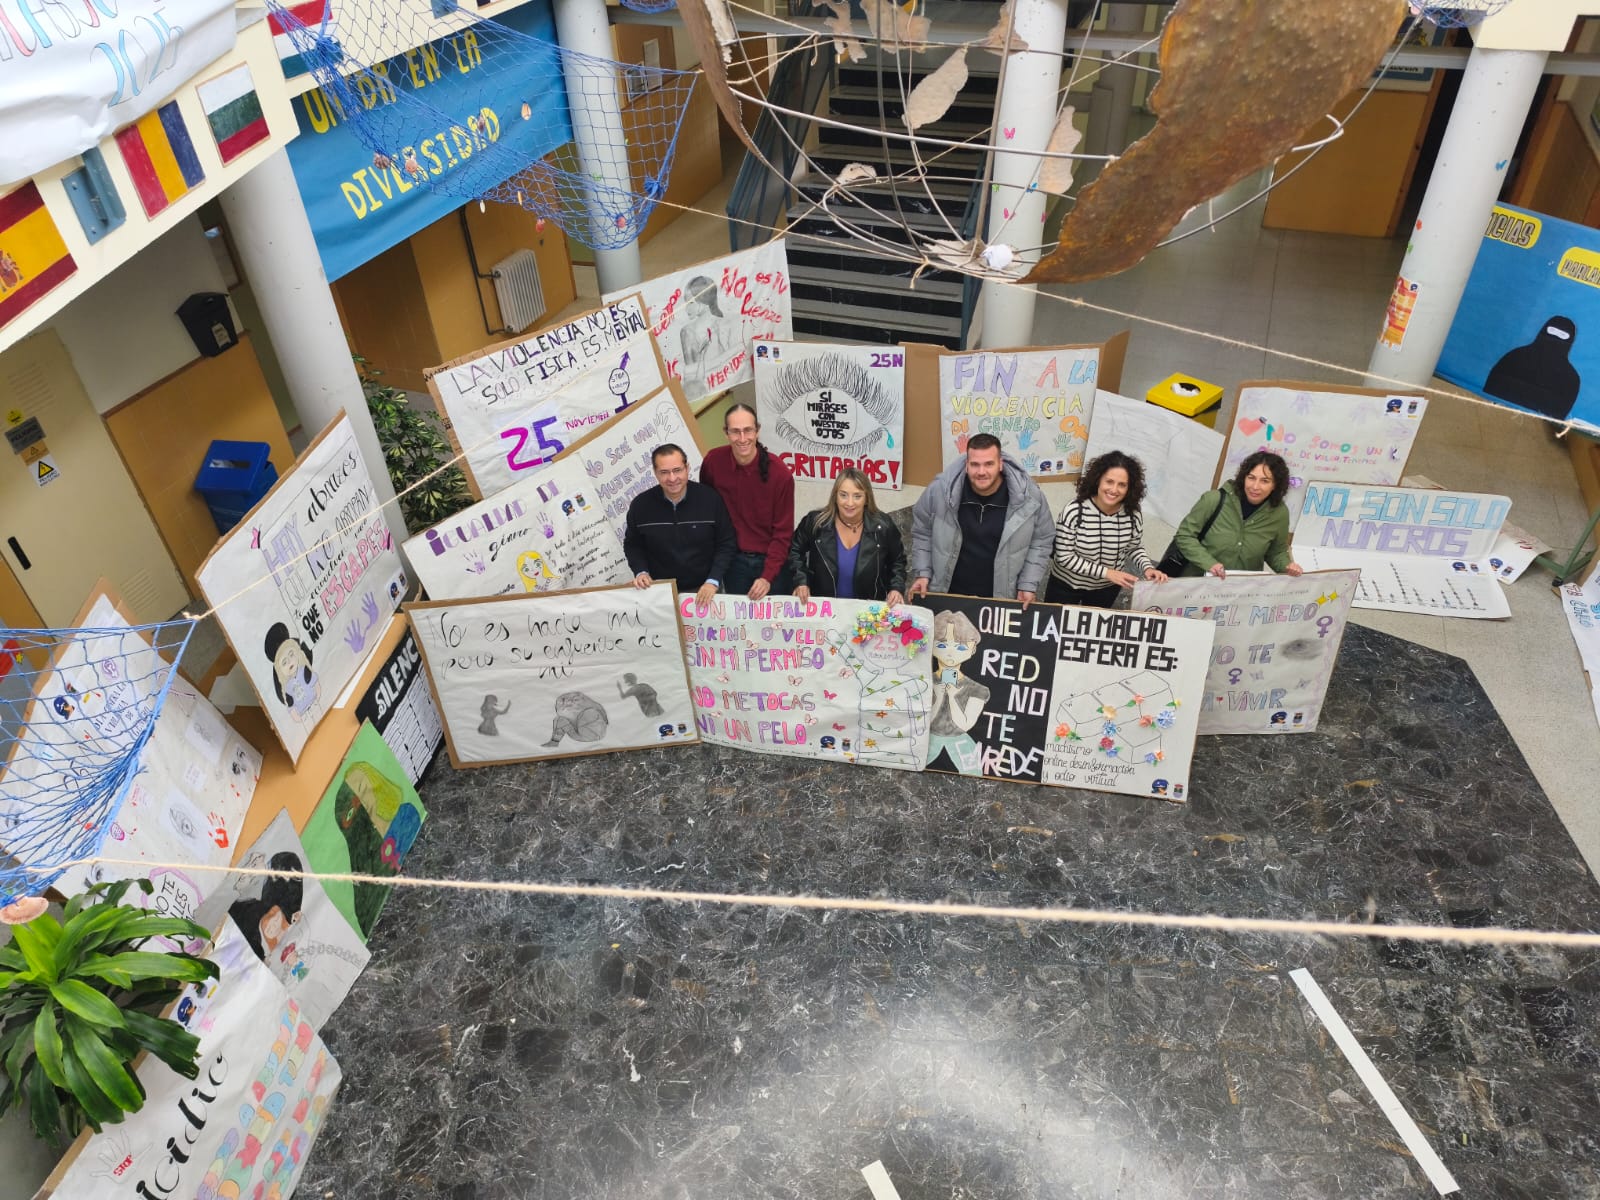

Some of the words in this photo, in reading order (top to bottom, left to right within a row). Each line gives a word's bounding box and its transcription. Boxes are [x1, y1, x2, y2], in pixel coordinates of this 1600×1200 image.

[406, 42, 441, 89] EN
[452, 29, 482, 74] LA
[1485, 212, 1536, 247] ICIAS
[450, 364, 492, 395] LA
[488, 322, 584, 373] VIOLENCIA
[586, 312, 606, 333] NO
[609, 303, 627, 321] ES
[870, 353, 904, 368] 25N
[482, 376, 521, 405] SOLO
[523, 351, 578, 385] FISICA
[581, 336, 601, 358] ES
[954, 354, 1018, 397] FIN
[1036, 357, 1060, 389] A
[1068, 359, 1097, 385] LA
[807, 402, 848, 414] MIRASES
[818, 413, 836, 421] CON
[811, 419, 850, 430] NUESTROS
[816, 428, 845, 440] OJOS
[500, 415, 565, 471] 25
[1303, 486, 1350, 518] NO
[1359, 490, 1429, 525] SON
[1428, 496, 1511, 530] SOLO
[302, 603, 320, 631] QUE
[680, 597, 727, 620] CON
[978, 606, 1022, 638] QUE
[1032, 611, 1060, 642] LA
[1249, 602, 1318, 626] MIEDO
[308, 620, 324, 643] NO
[424, 611, 467, 649] No
[483, 621, 511, 643] es
[682, 624, 747, 643] BIKINI
[782, 628, 826, 645] VELO
[1062, 610, 1093, 636] LA
[1097, 611, 1168, 644] MACHO
[745, 644, 825, 673] PERMISO
[874, 635, 899, 652] 25
[1059, 637, 1140, 669] ESFERA
[1249, 643, 1275, 664] TE
[375, 637, 419, 720] SILENC
[980, 649, 1041, 683] RED
[1008, 684, 1049, 717] NO
[724, 718, 752, 743] UN
[983, 711, 1017, 744] TE
